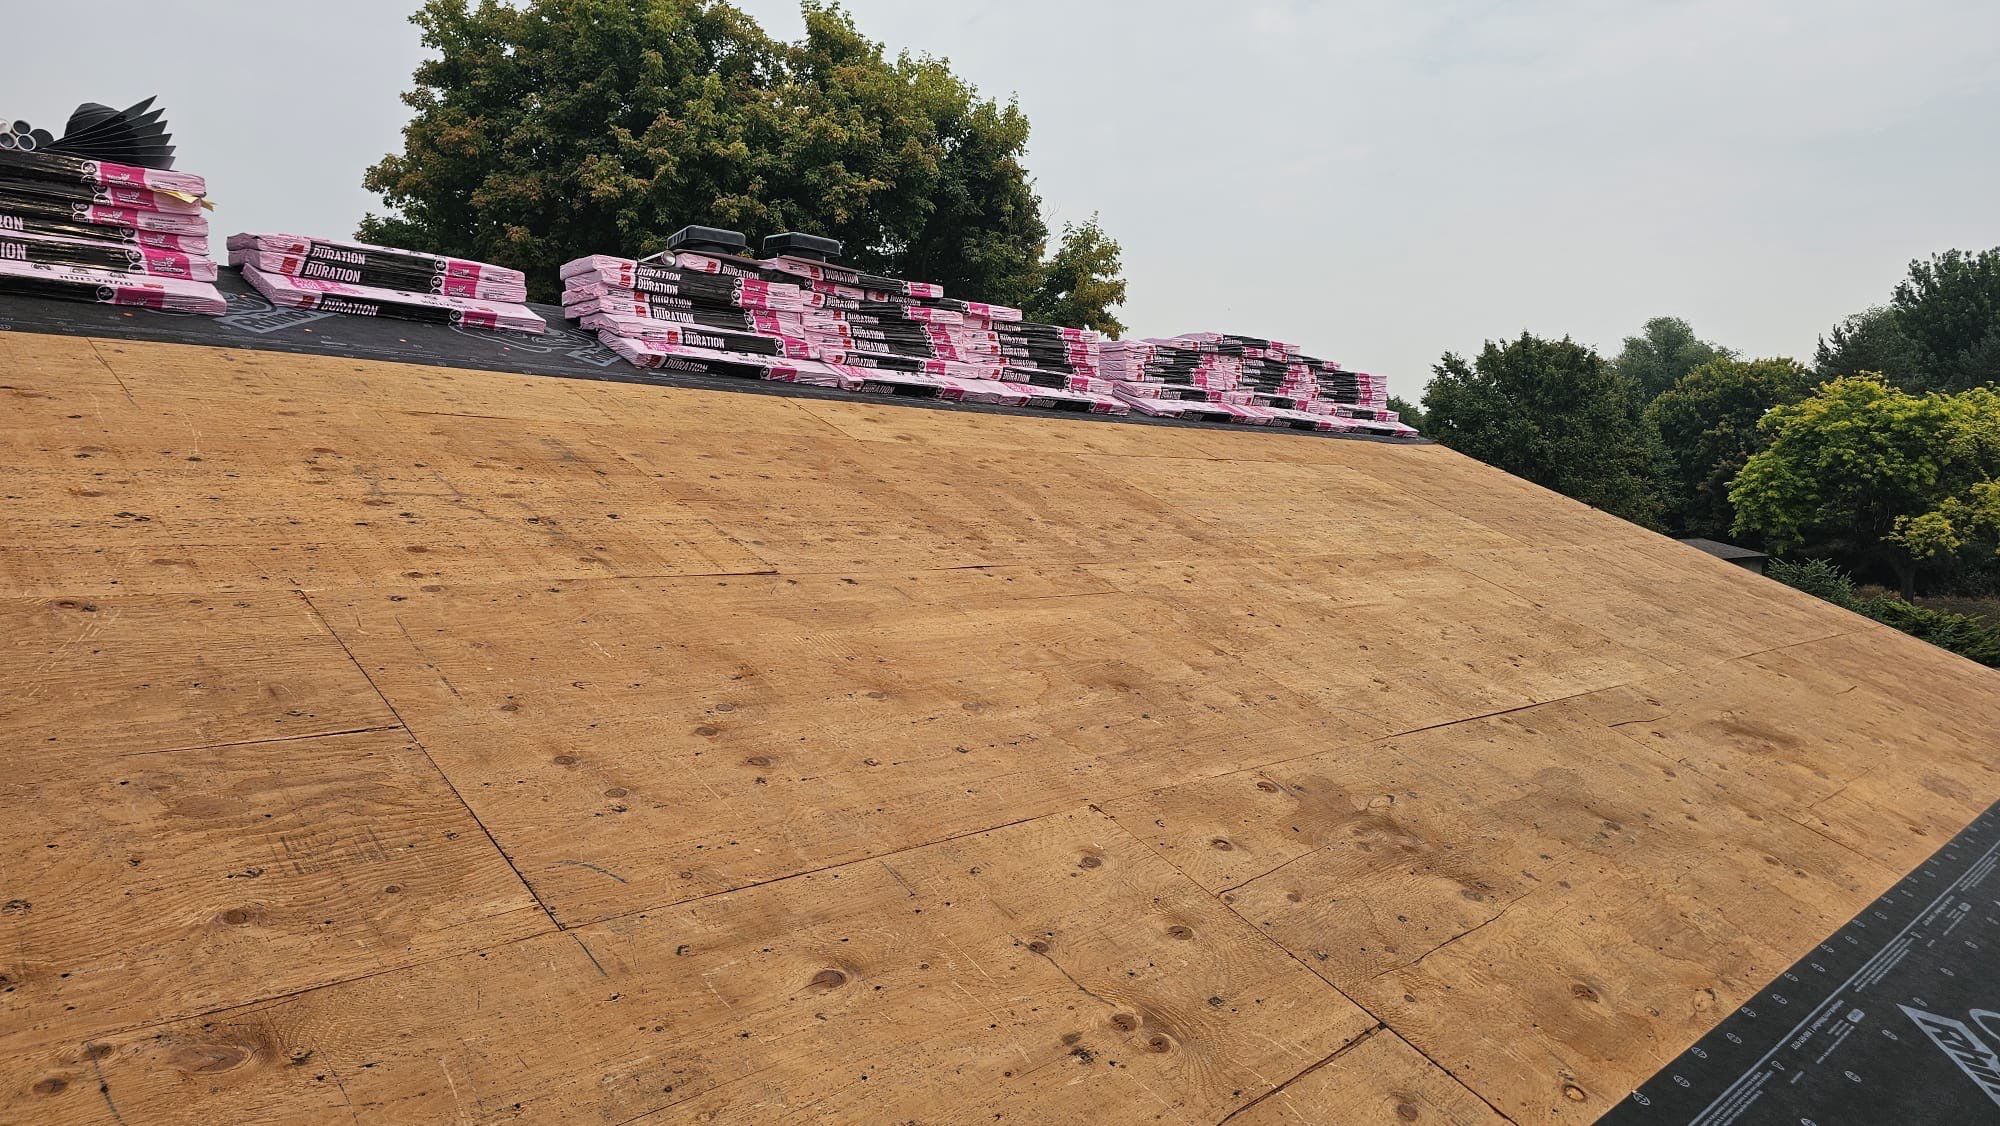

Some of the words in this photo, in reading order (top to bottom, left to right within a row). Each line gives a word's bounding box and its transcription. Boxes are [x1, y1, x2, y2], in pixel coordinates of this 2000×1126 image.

[311, 247, 366, 265] DURATION
[304, 262, 361, 283] DURATION
[637, 266, 681, 282] DURATION
[722, 265, 760, 280] DURATION
[825, 270, 859, 285] DURATION
[637, 278, 679, 296] DURATION
[321, 299, 379, 317] DURATION
[826, 298, 860, 310] DURATION
[653, 307, 695, 325] DURATION
[847, 312, 879, 324] DURATION
[852, 327, 885, 340] DURATION
[993, 324, 1021, 333] DURATION
[684, 333, 725, 349] DURATION
[856, 340, 890, 353] DURATION
[1002, 347, 1030, 358] DURATION
[664, 358, 709, 373] DURATION
[846, 356, 878, 369] DURATION
[1002, 371, 1031, 383] DURATION
[861, 383, 896, 394] DURATION
